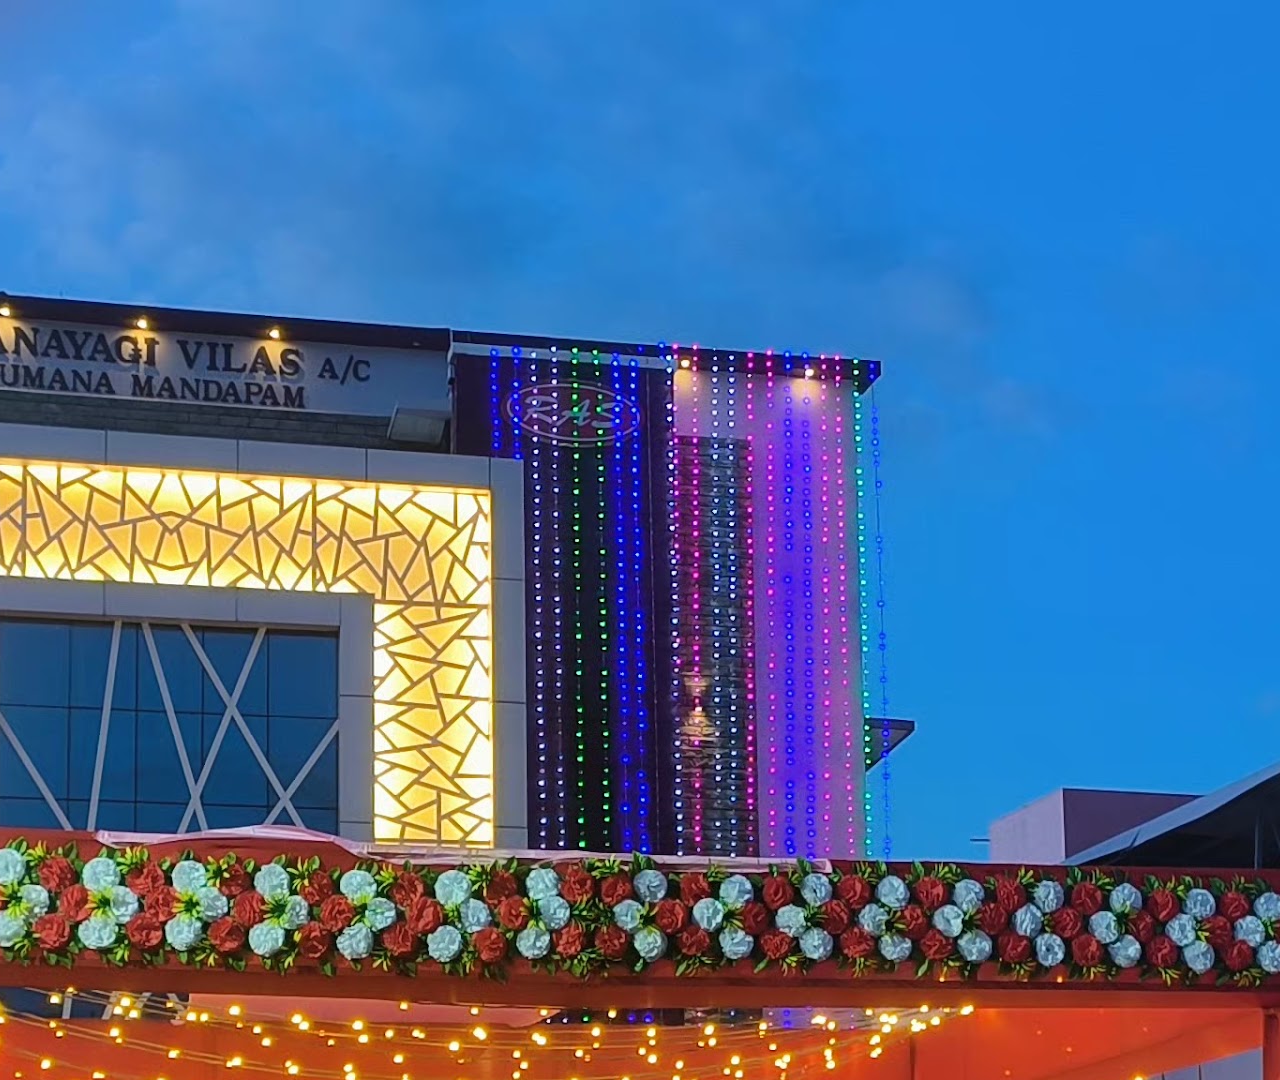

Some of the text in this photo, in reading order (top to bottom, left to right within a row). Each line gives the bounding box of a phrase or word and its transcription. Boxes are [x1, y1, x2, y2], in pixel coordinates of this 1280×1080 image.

[177, 339, 303, 376] VILAS
[317, 354, 371, 385] A/C
[130, 374, 306, 408] MANDAPAM
